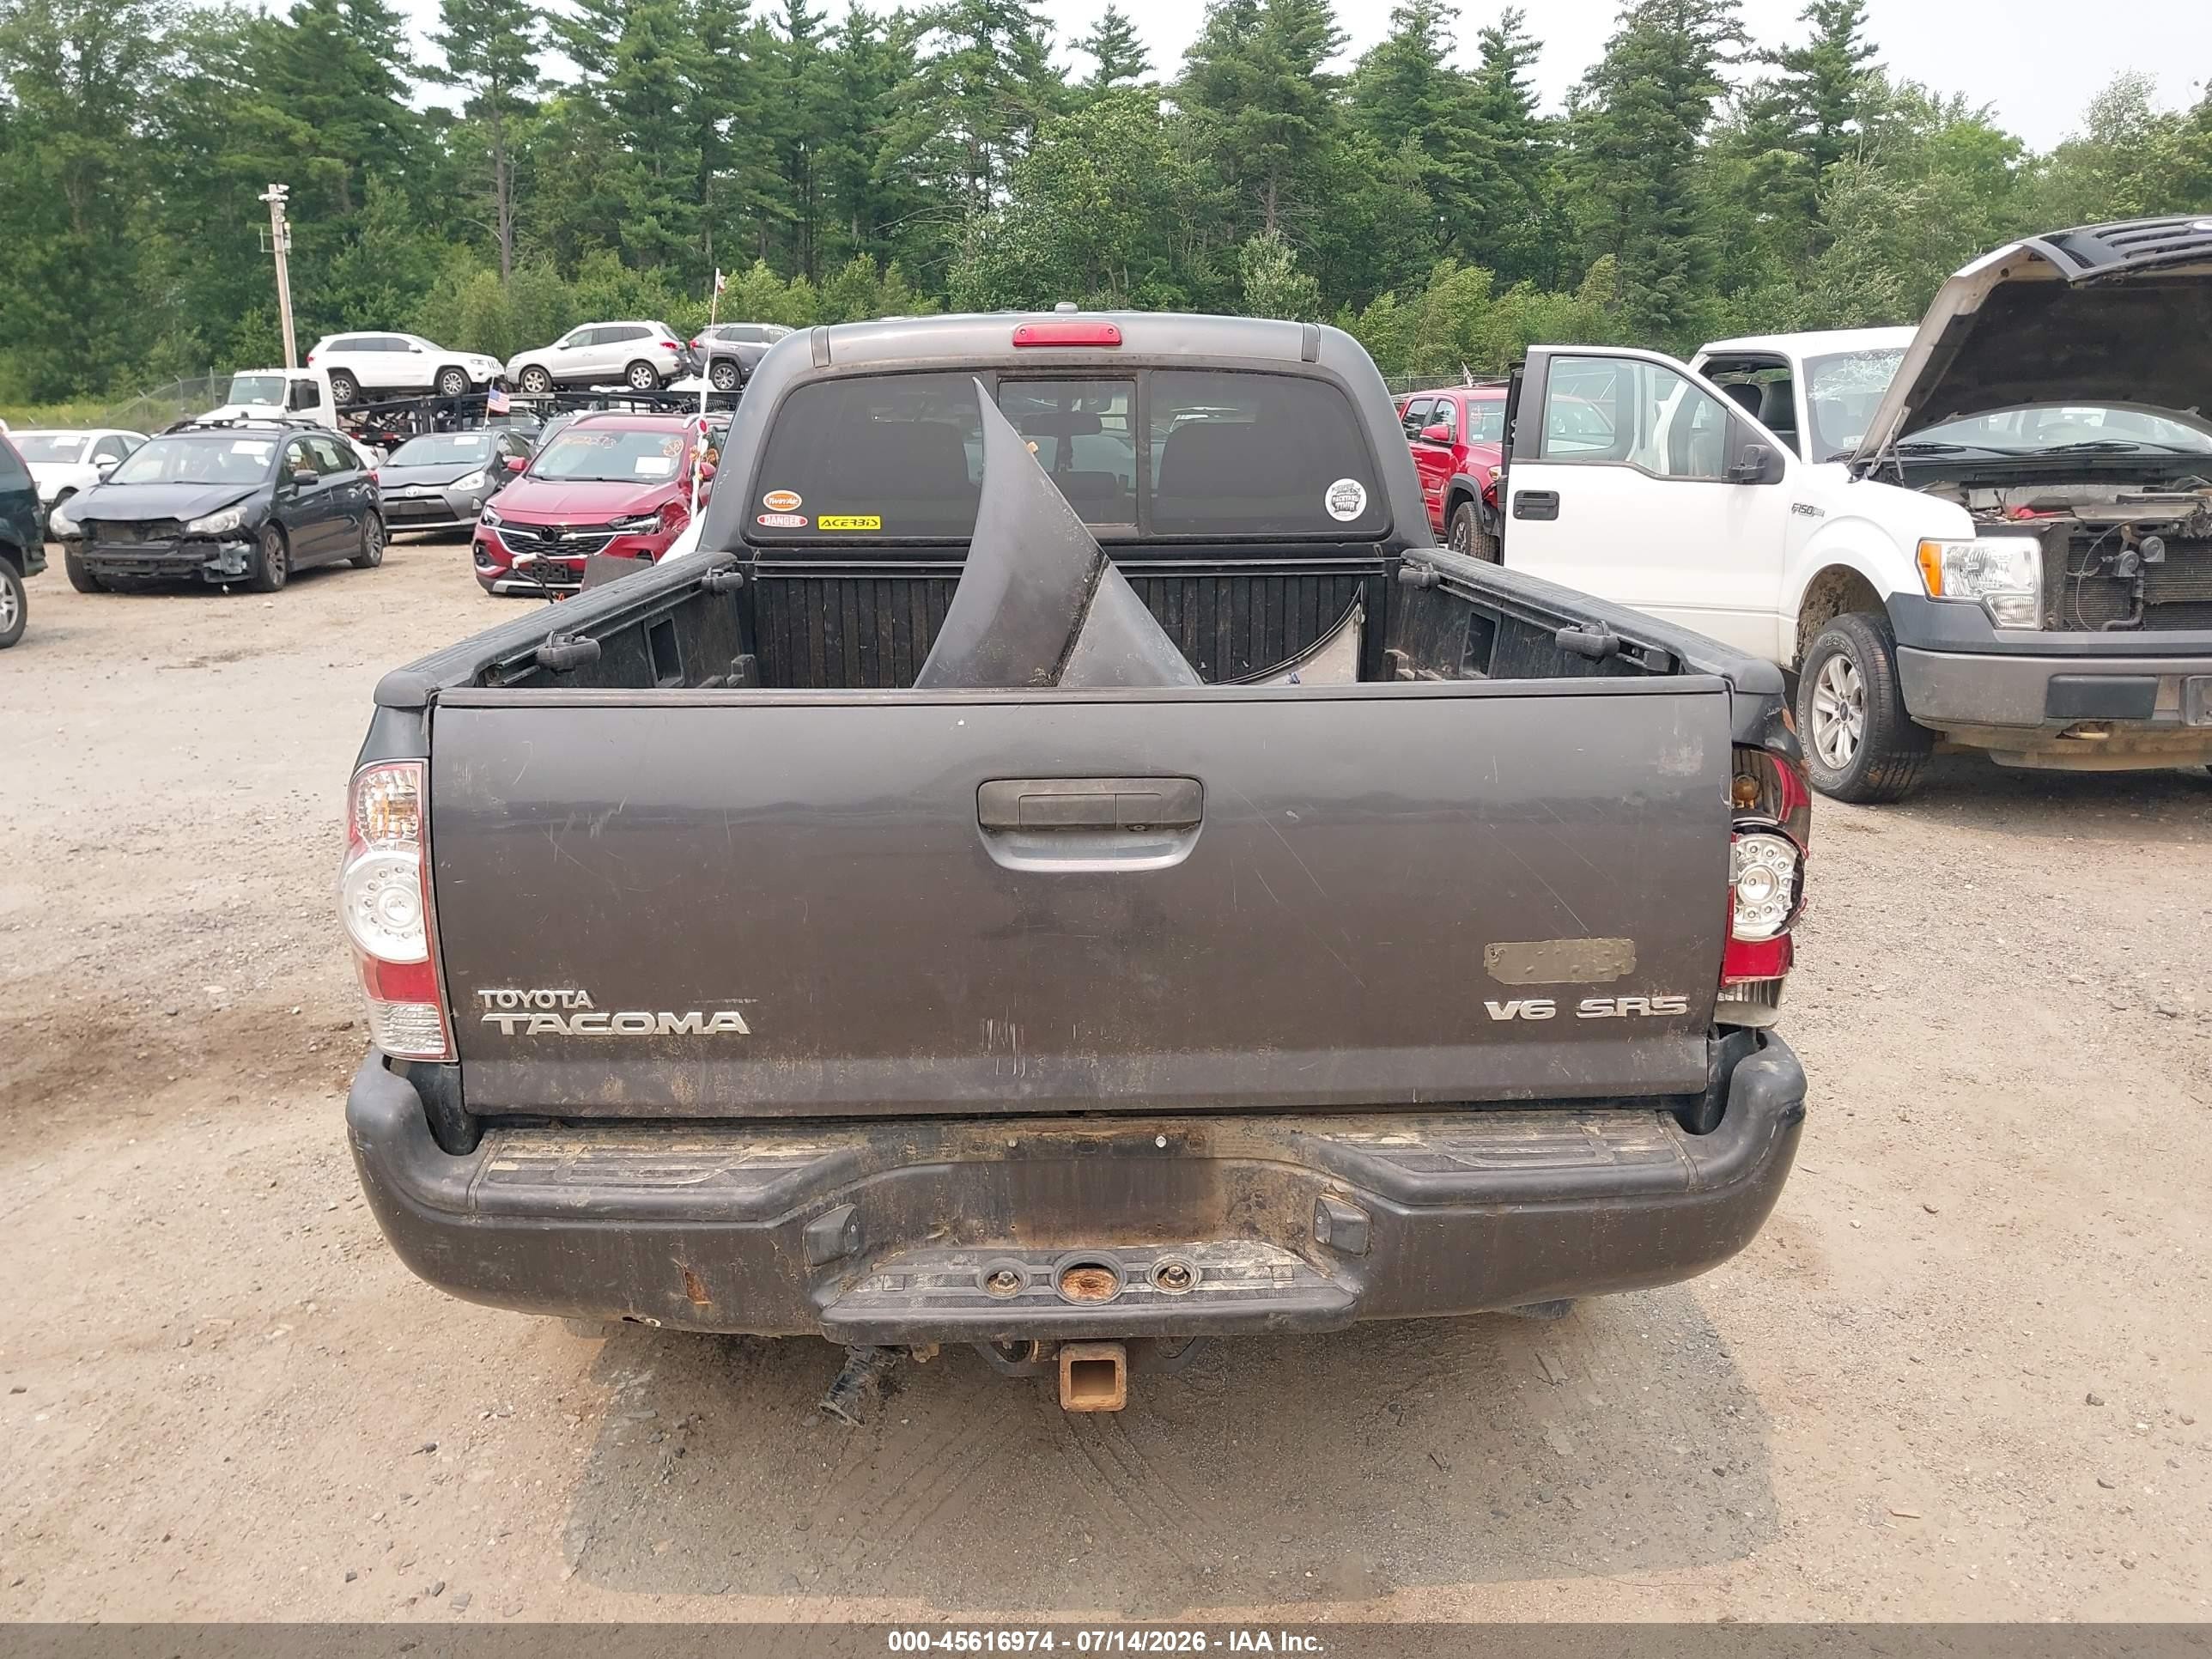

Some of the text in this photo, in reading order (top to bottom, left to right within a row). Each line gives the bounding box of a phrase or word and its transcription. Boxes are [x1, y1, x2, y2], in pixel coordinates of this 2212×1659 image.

[763, 515, 800, 526] DANGER
[477, 989, 595, 1010] TOYOTA
[1484, 995, 1689, 1021] V6 SR5
[481, 1011, 751, 1036] TACOMA
